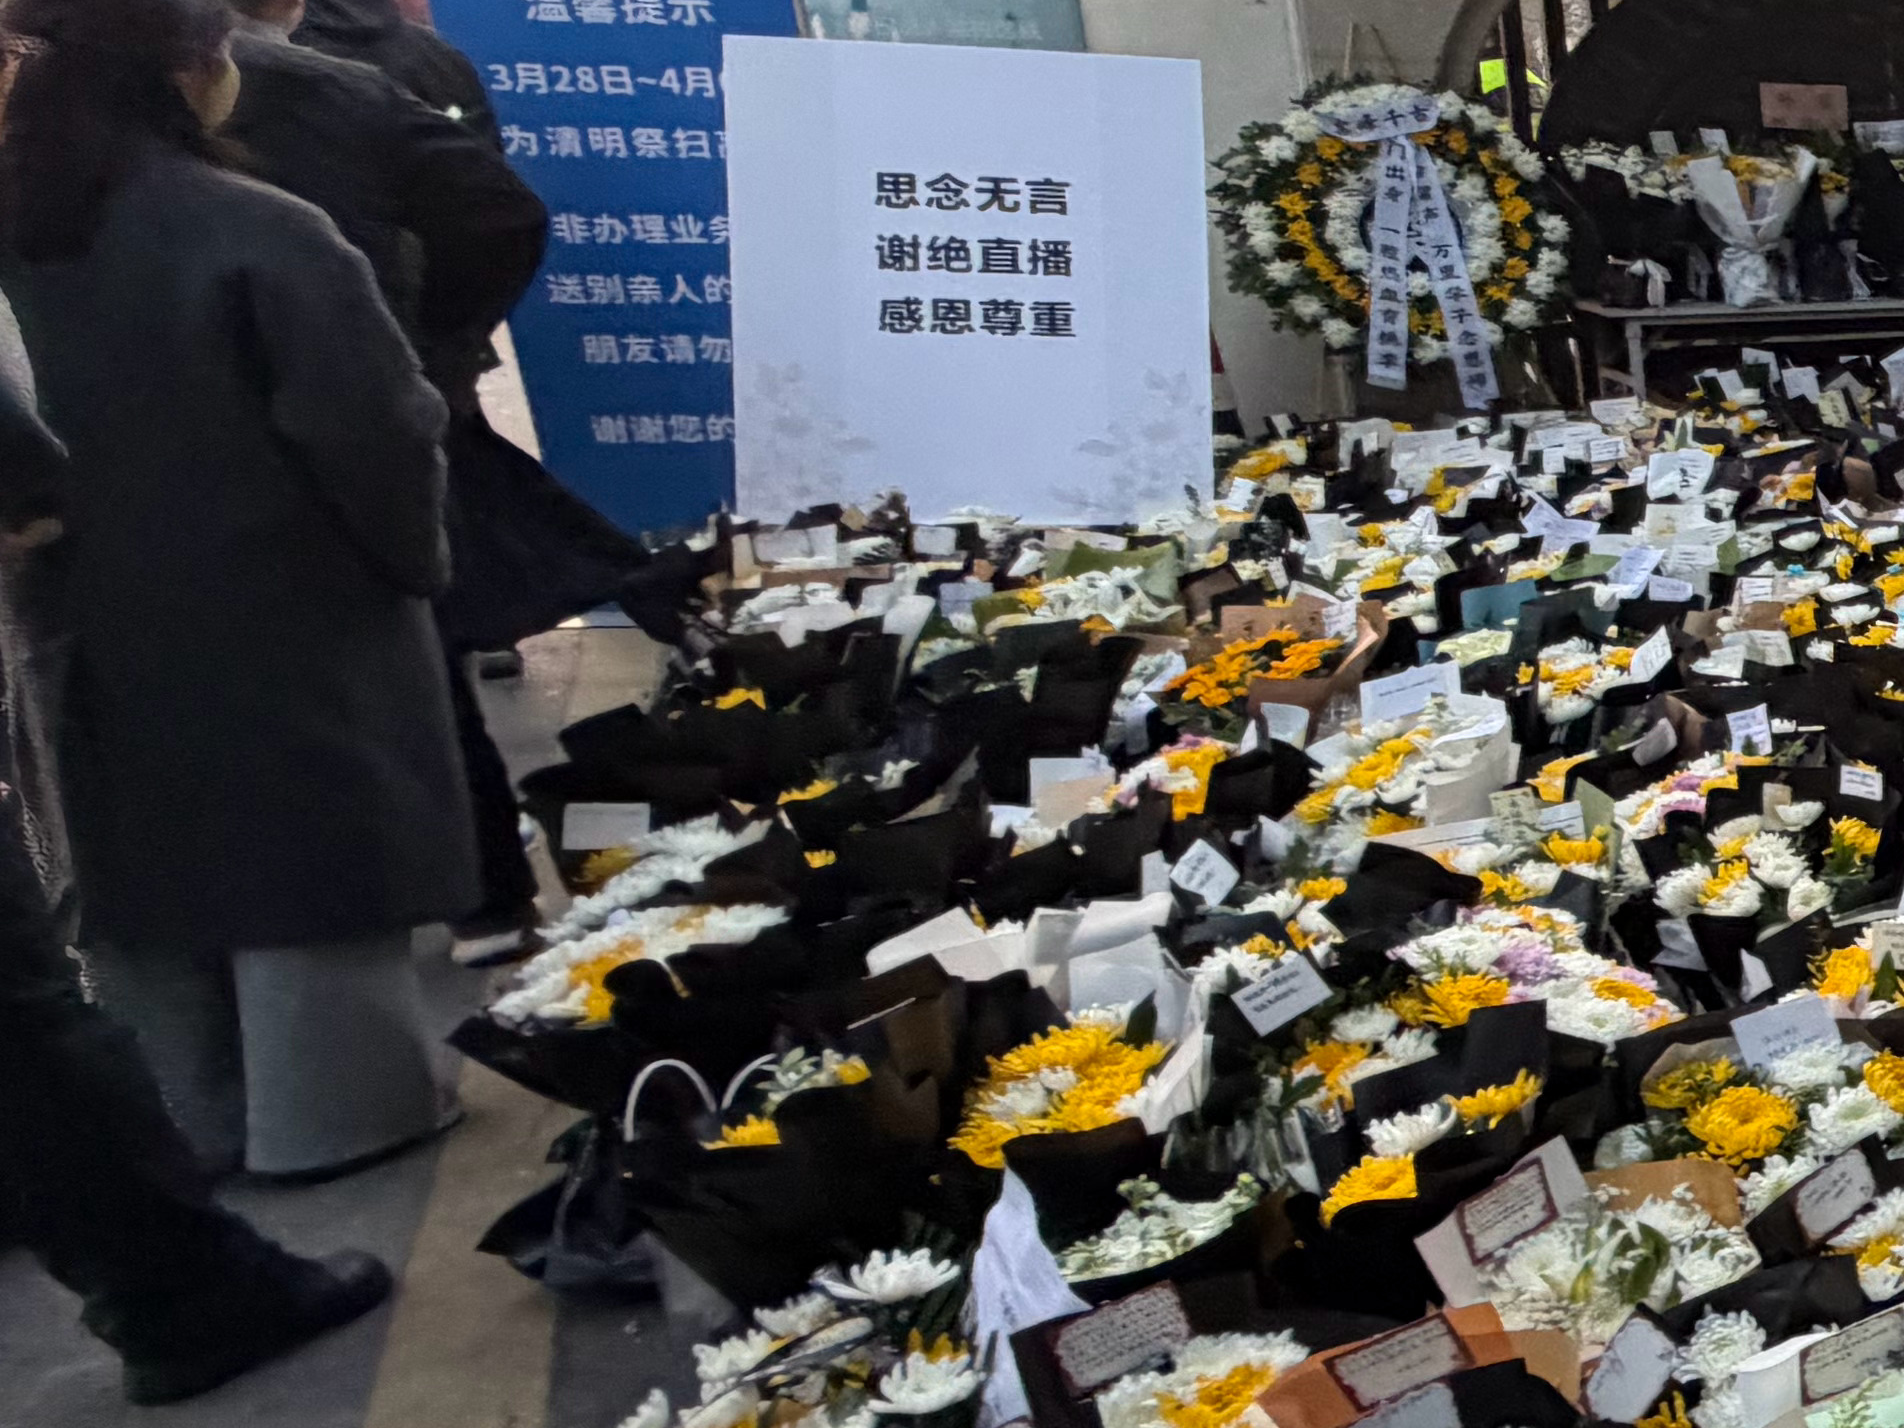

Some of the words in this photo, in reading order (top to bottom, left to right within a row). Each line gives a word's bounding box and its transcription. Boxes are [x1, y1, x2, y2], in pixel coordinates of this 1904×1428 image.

[487, 62, 725, 98] 3月28日~4月
[874, 171, 1072, 215] 思念无言
[875, 234, 1073, 277] 谢绝直播
[878, 296, 1077, 338] 感恩尊重
